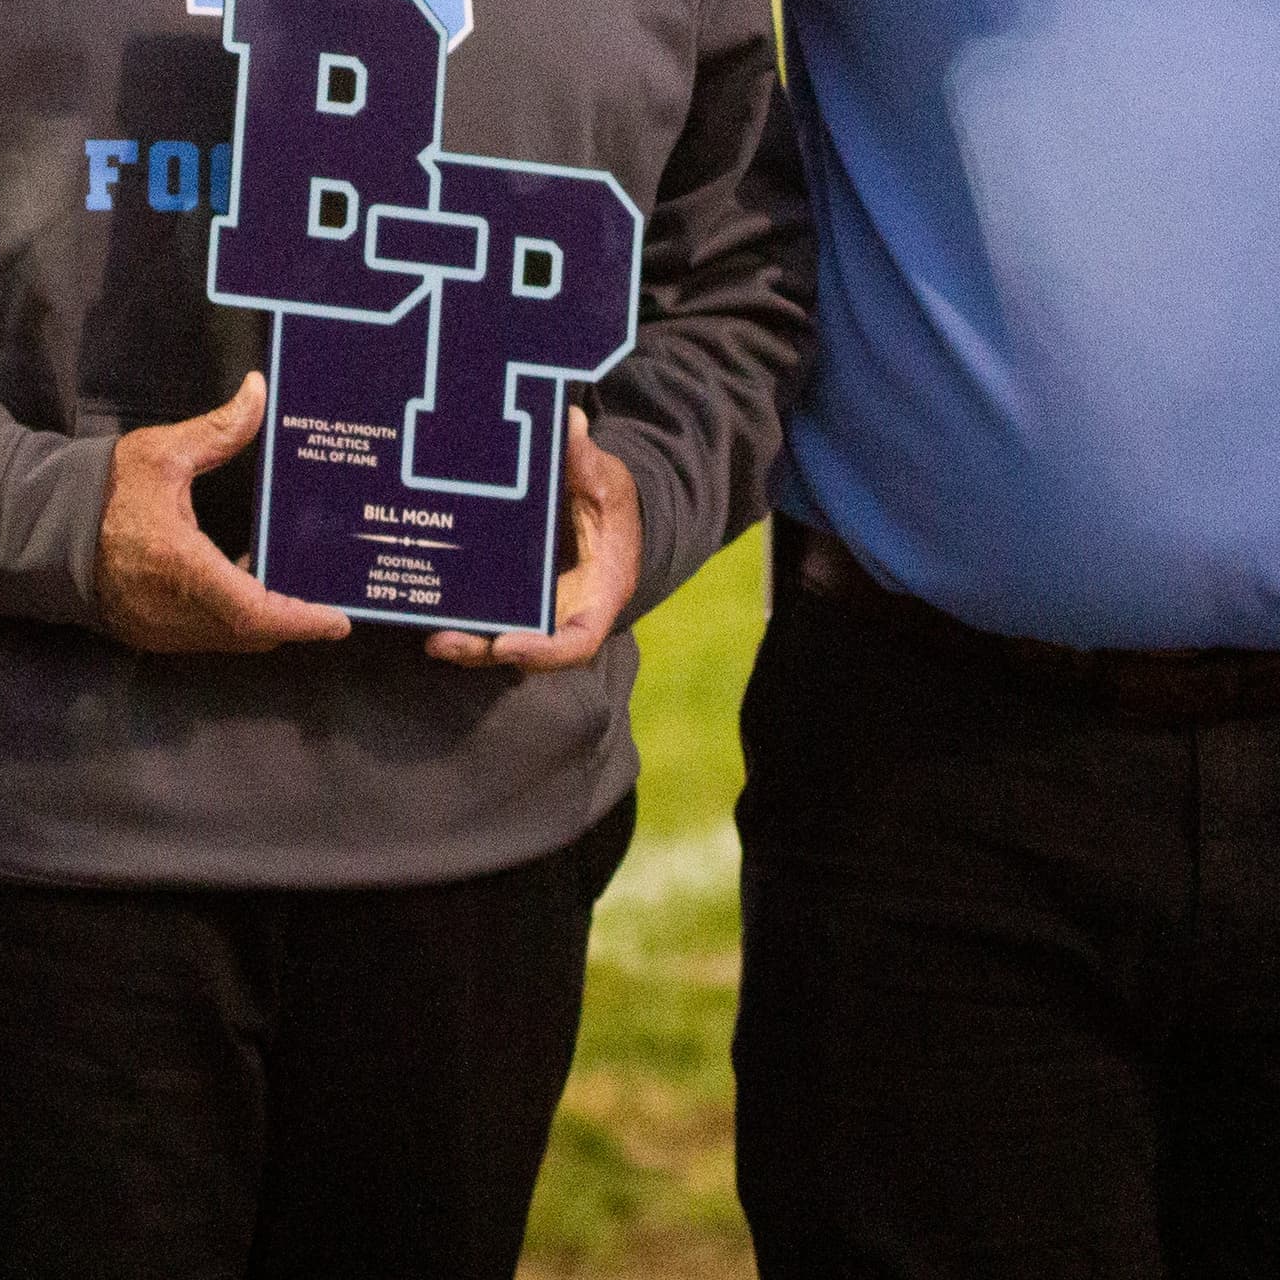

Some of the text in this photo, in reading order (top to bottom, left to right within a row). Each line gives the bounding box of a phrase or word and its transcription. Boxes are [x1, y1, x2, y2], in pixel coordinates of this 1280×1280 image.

[283, 416, 397, 439] BRISTOL-PLYMOUTH
[308, 435, 370, 451] ATHLETICS
[297, 448, 378, 468] HALL OF FAME
[363, 503, 454, 530] BILL MOAN
[377, 556, 433, 570] FOOTBALL
[368, 569, 441, 587] HEAD COACH
[408, 587, 442, 606] 2007
